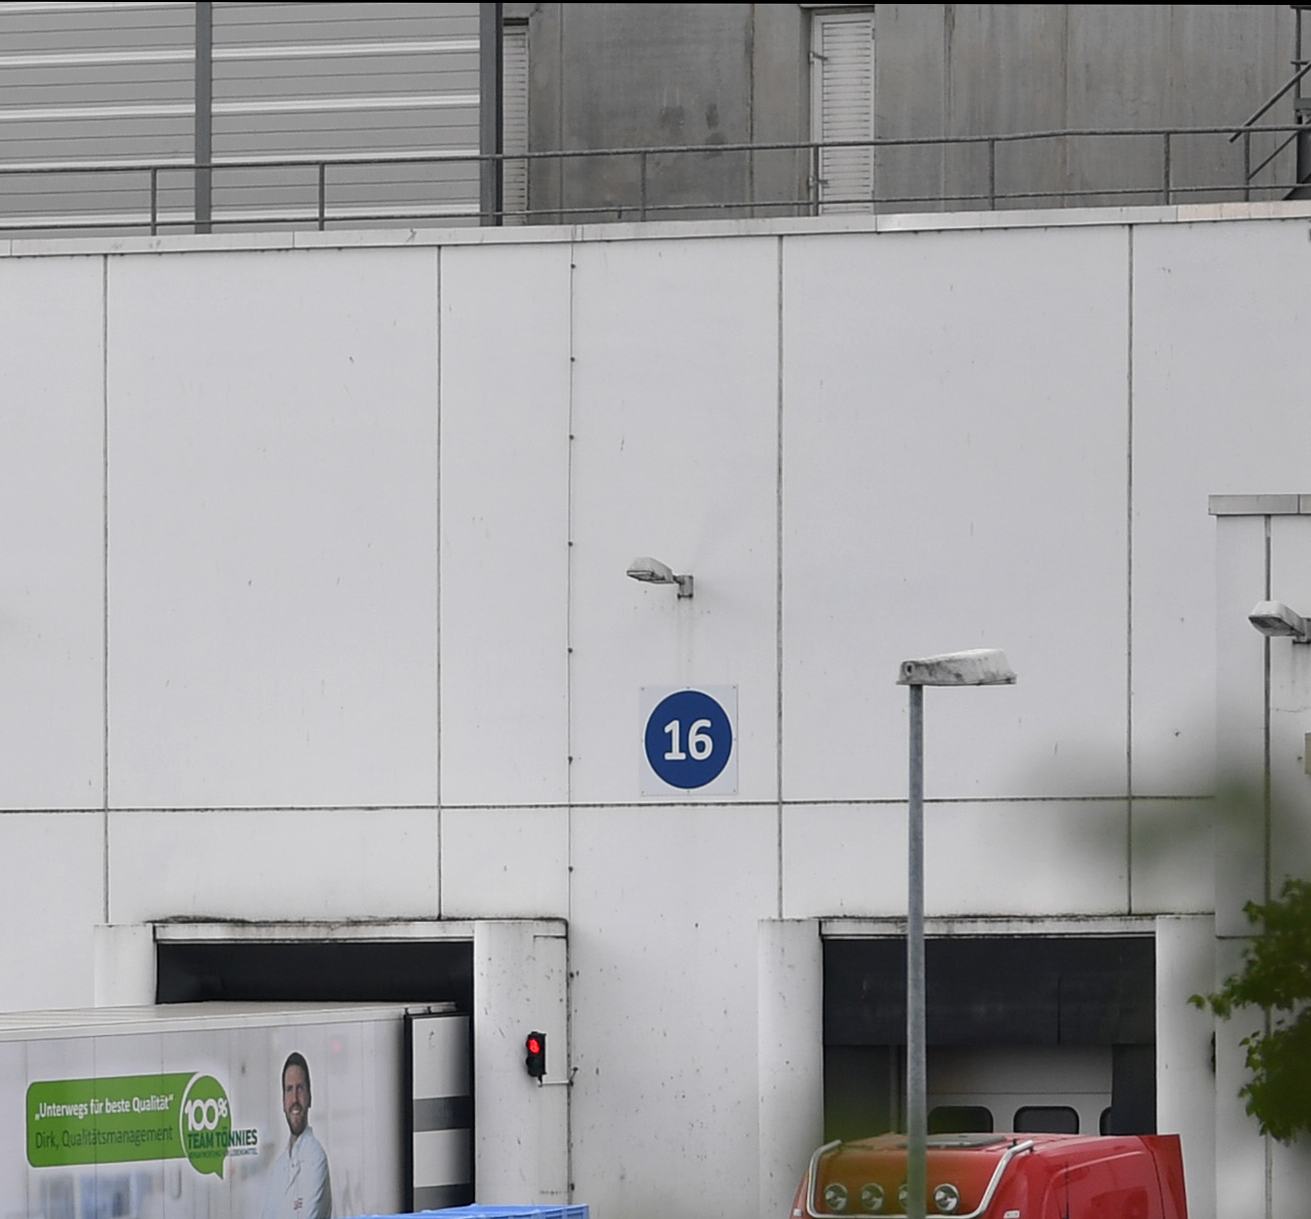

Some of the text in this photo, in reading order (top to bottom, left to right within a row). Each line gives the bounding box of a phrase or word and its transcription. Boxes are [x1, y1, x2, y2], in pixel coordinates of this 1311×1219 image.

[664, 719, 714, 761] 16
[90, 1099, 104, 1114] für
[105, 1098, 130, 1113] beste
[185, 1098, 228, 1131] 100%
[35, 1125, 173, 1150] Dirk, Qualitätsmanagement
[187, 1126, 258, 1149] TEAM TÖNNIES
